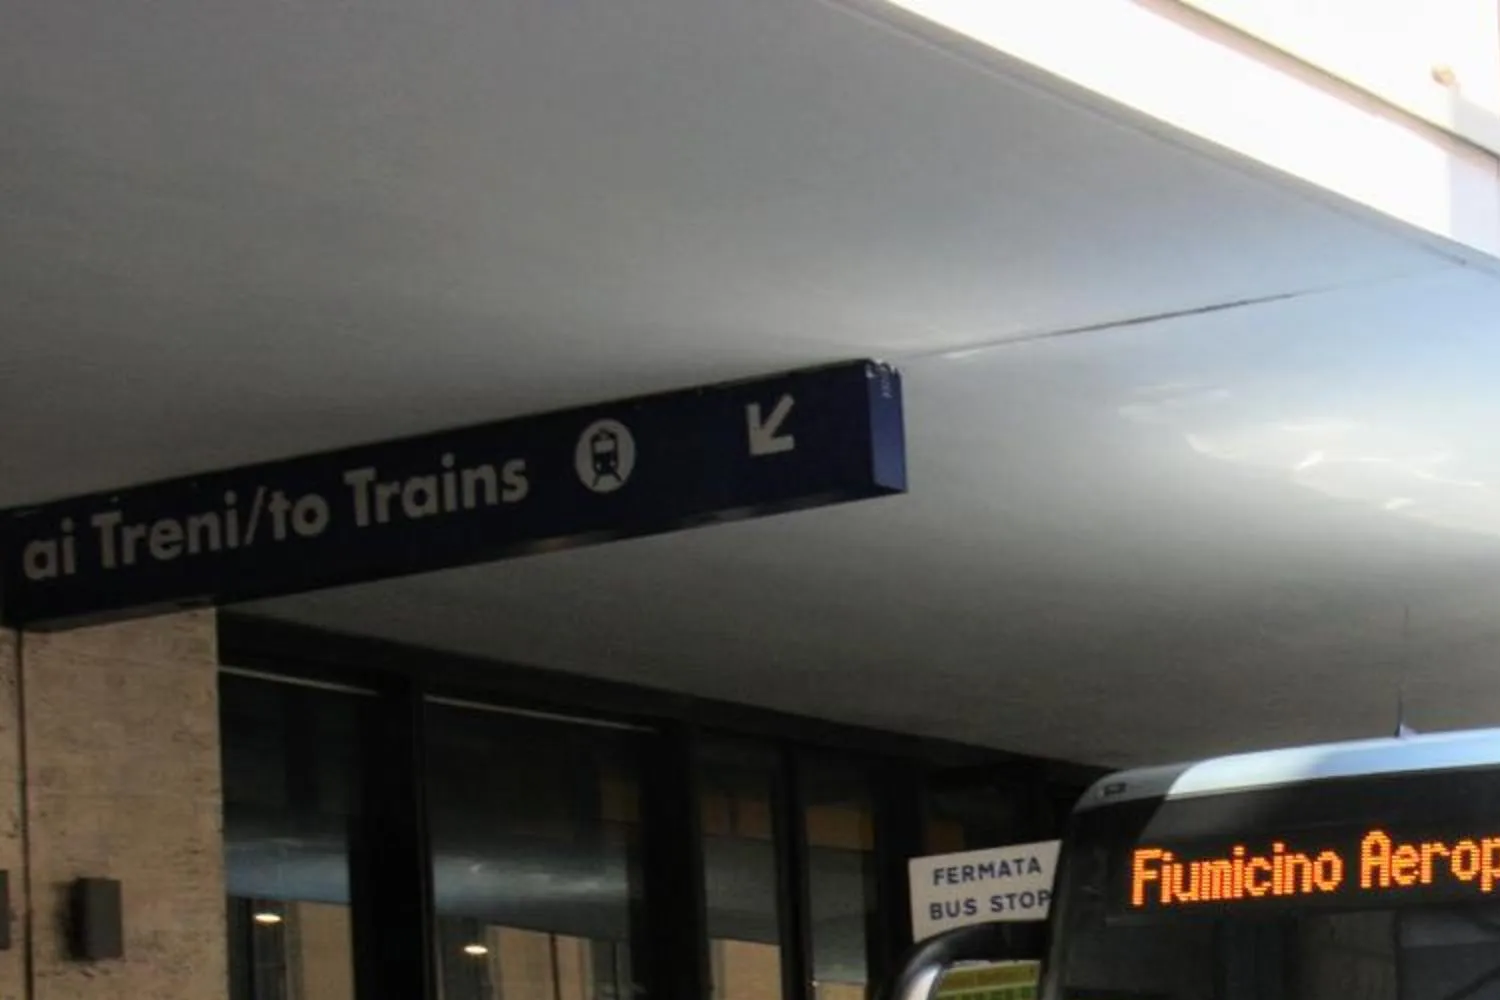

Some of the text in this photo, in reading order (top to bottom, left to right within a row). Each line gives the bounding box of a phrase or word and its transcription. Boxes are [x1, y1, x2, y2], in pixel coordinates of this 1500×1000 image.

[23, 516, 76, 580] ai
[343, 452, 529, 527] Trains
[932, 856, 1043, 886] FERMATA
[1131, 842, 1342, 907] Fiumicino
[929, 890, 1051, 921] BUS STOP
